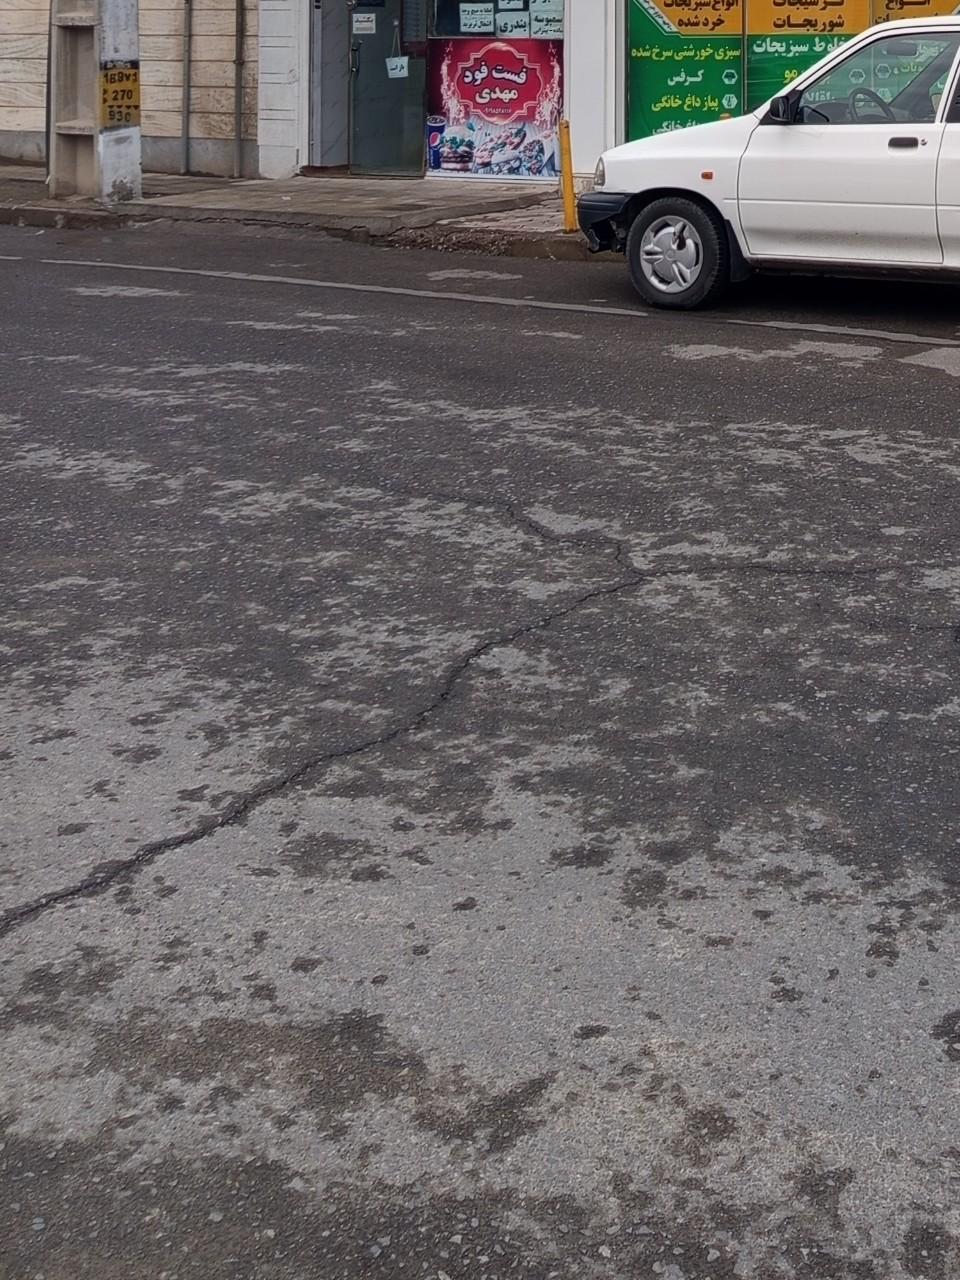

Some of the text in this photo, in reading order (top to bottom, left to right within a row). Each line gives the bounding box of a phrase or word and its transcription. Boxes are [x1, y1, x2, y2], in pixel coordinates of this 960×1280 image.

[500, 19, 527, 33] بندری
[677, 14, 725, 31] خرد شده
[773, 14, 845, 32] شوریجات
[631, 43, 741, 61] سبزی خورشتی سرخ شده
[752, 36, 847, 58] خلوط سبزیجات
[463, 61, 527, 86] فست فود
[667, 68, 704, 86] کرفس
[112, 89, 133, 101] 270
[475, 86, 519, 104] مهدی
[651, 93, 719, 112] پیاز داغ خانگی
